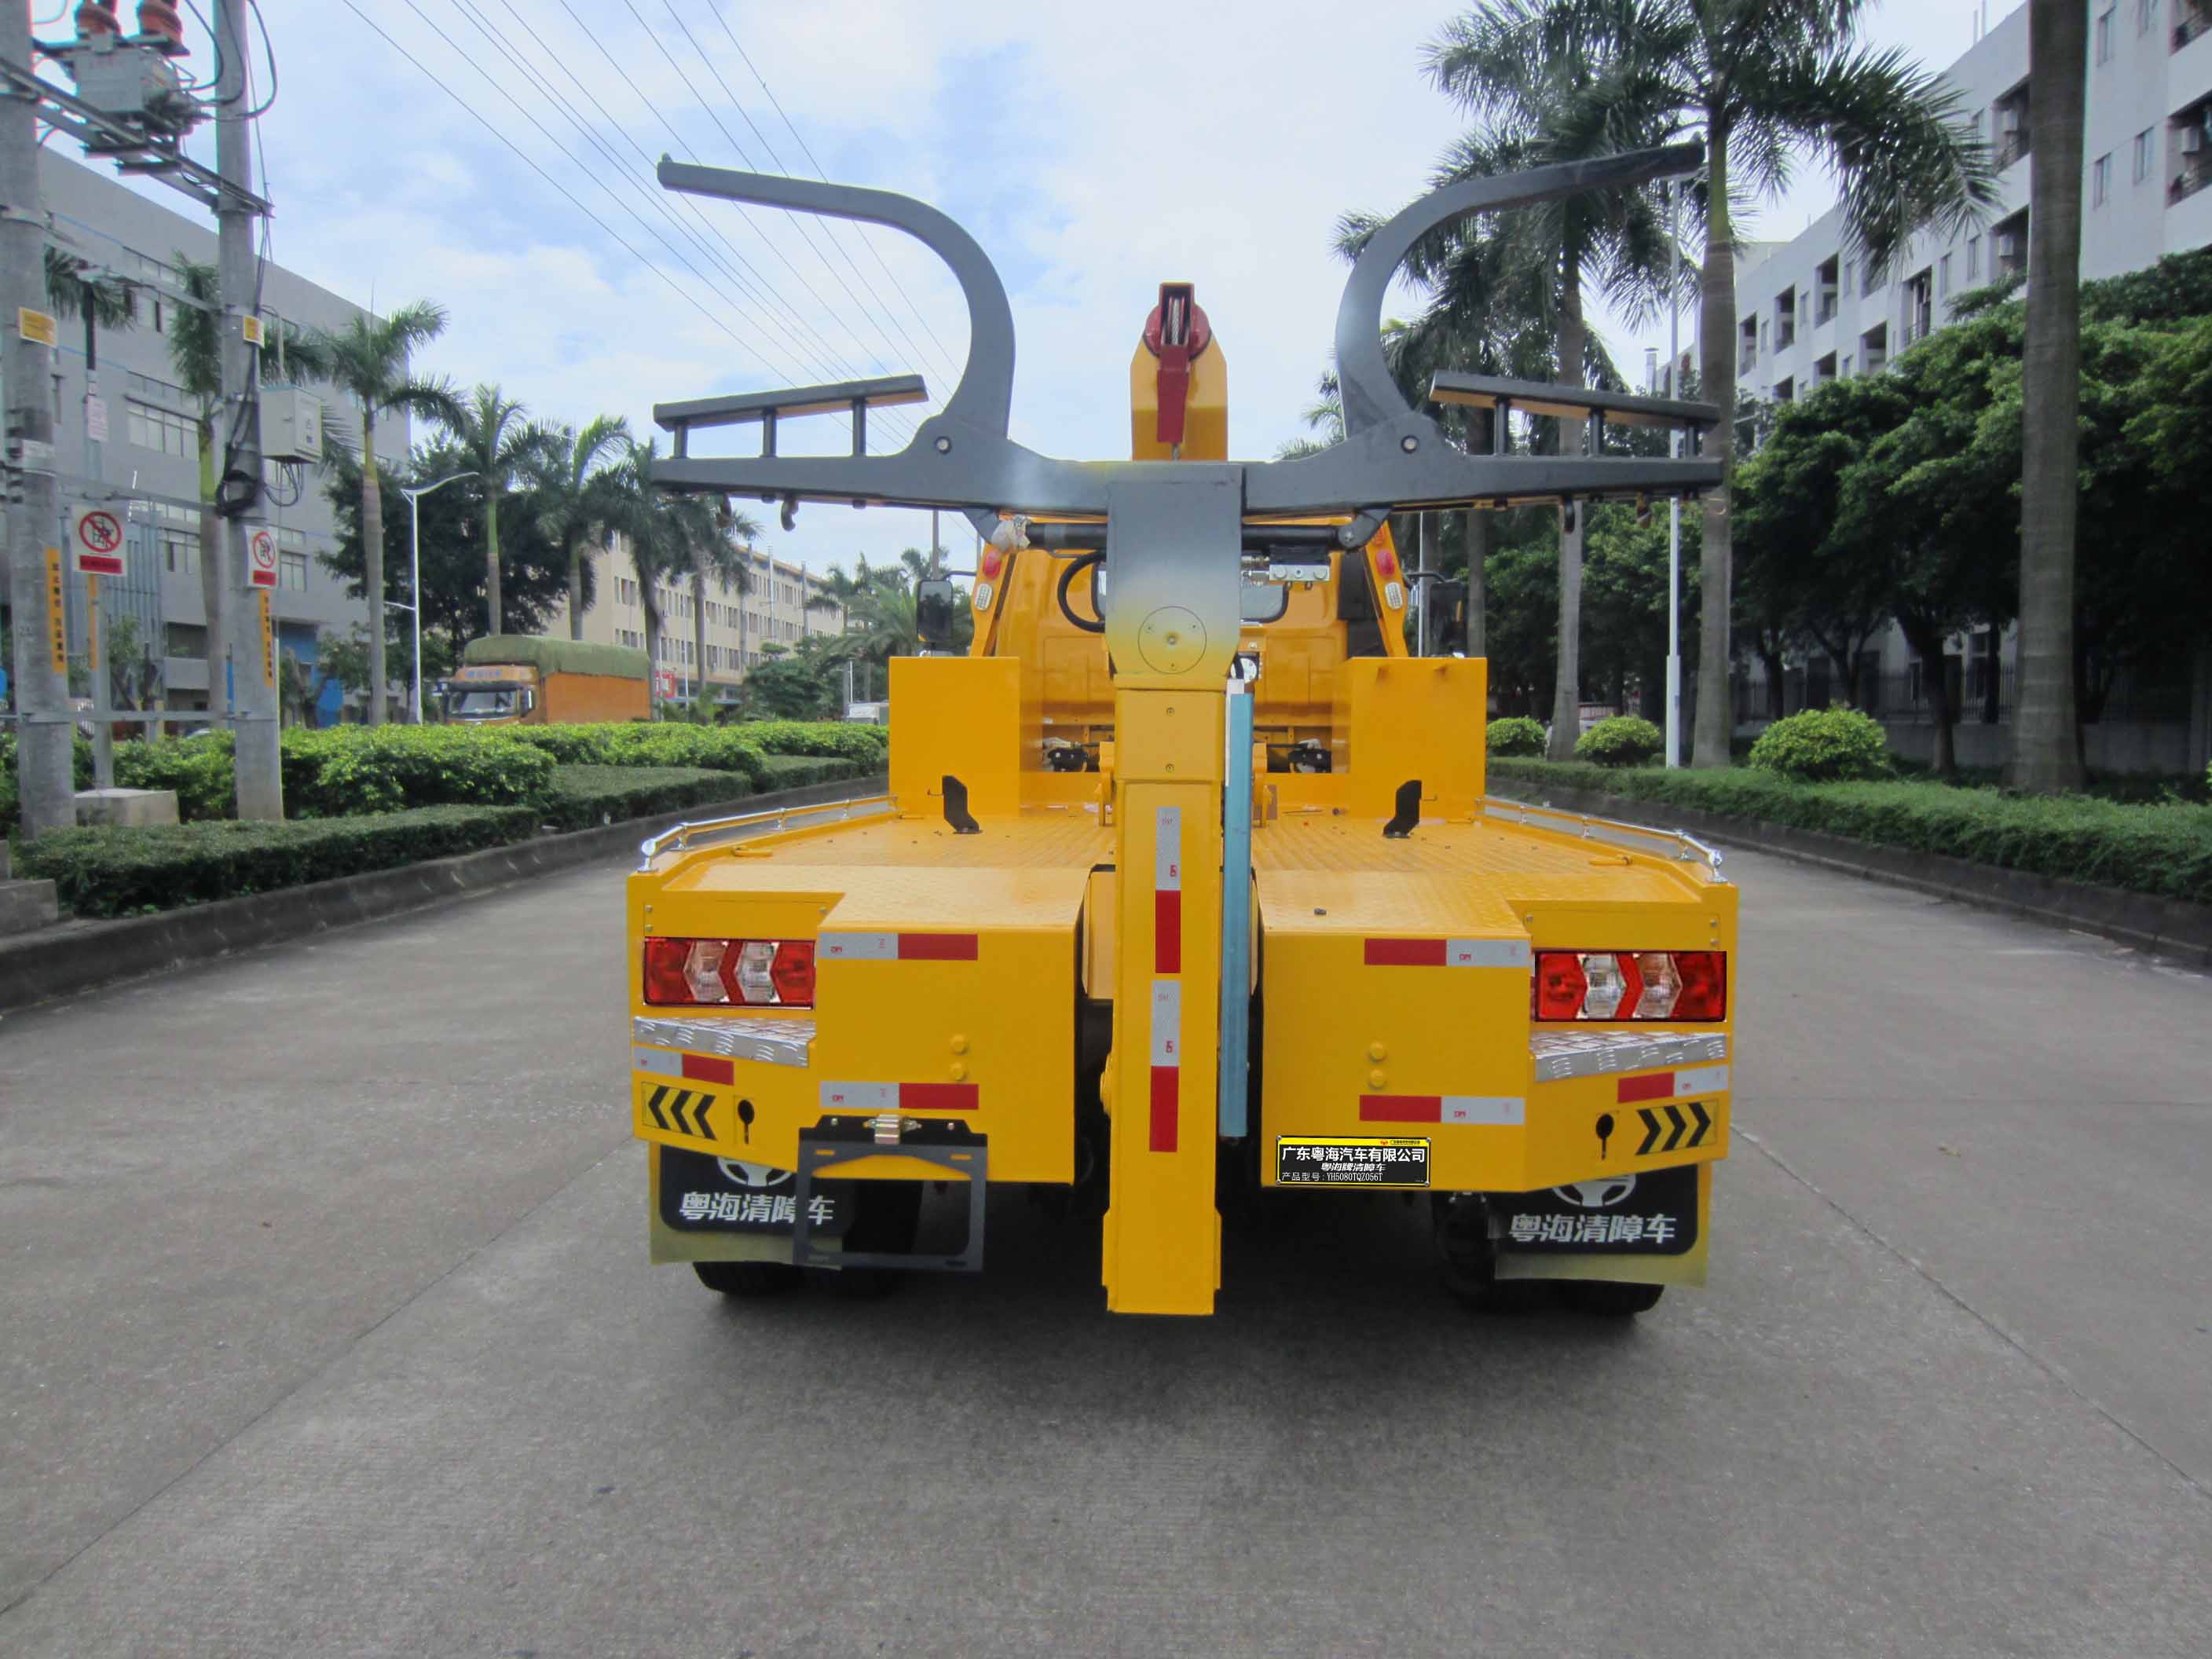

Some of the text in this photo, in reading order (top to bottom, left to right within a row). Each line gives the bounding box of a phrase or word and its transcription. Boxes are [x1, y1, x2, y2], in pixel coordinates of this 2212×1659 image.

[1282, 1146, 1425, 1163] 广东粤海汽车有限公司
[1321, 1163, 1386, 1172] 粤海牌清障车
[1509, 1214, 1676, 1243] 粤海清障车
